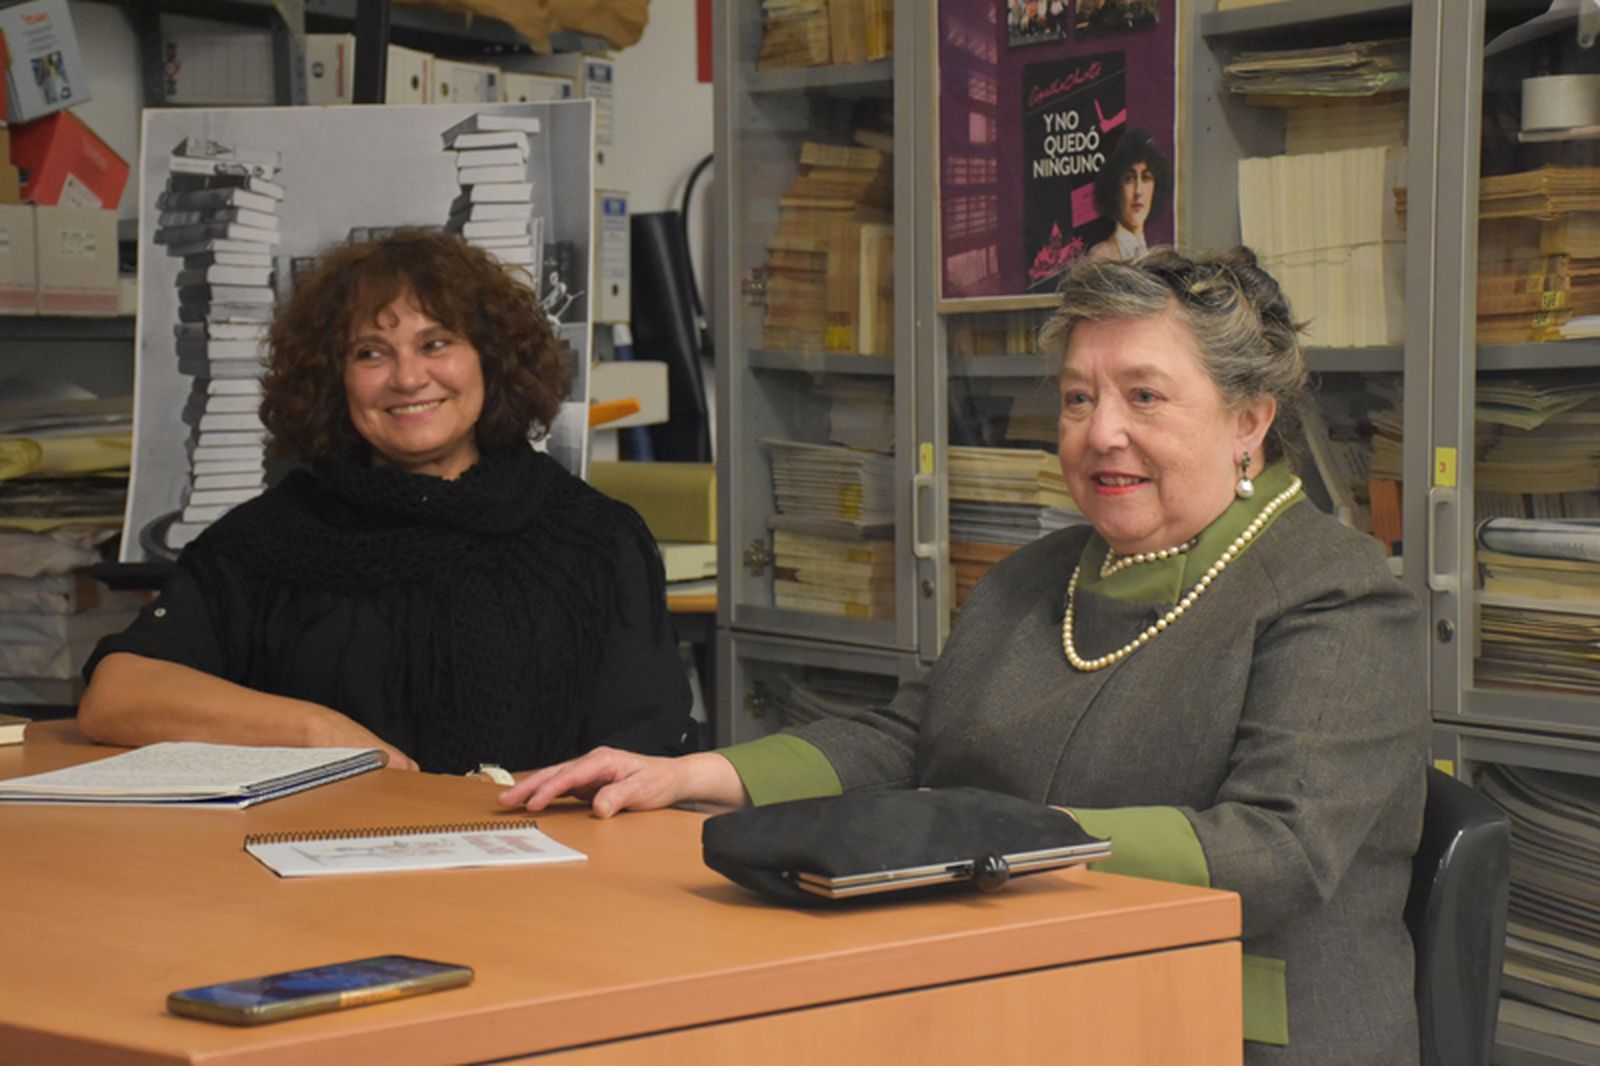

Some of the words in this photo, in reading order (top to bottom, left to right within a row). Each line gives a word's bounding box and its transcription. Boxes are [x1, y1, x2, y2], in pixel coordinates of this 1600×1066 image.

[1043, 113, 1054, 133] Y
[1055, 110, 1080, 132] NO
[1044, 125, 1100, 159] QUEDÓ
